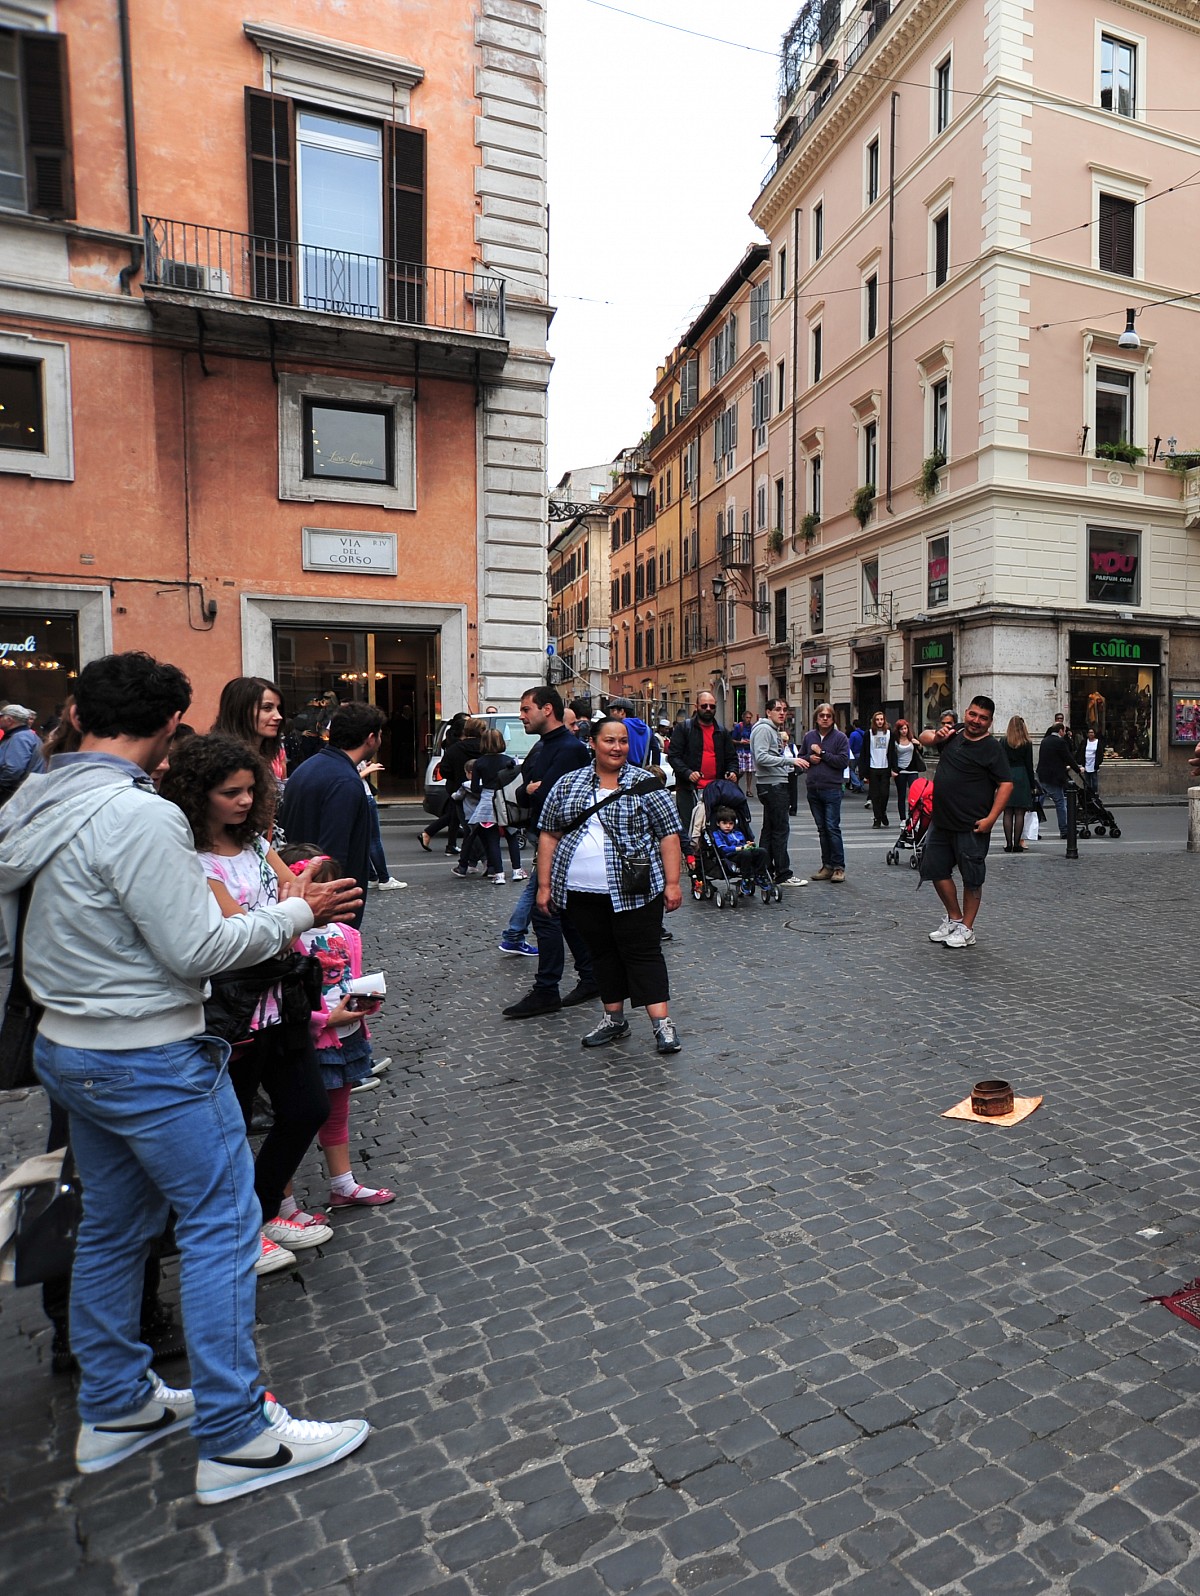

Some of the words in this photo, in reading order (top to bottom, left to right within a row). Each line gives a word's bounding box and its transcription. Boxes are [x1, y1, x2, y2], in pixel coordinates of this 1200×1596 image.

[340, 538, 361, 548] VIA
[329, 554, 372, 565] CORSO
[1090, 551, 1136, 573] YOU
[0, 635, 36, 658] gnoli
[1092, 638, 1141, 658] ESOTICA
